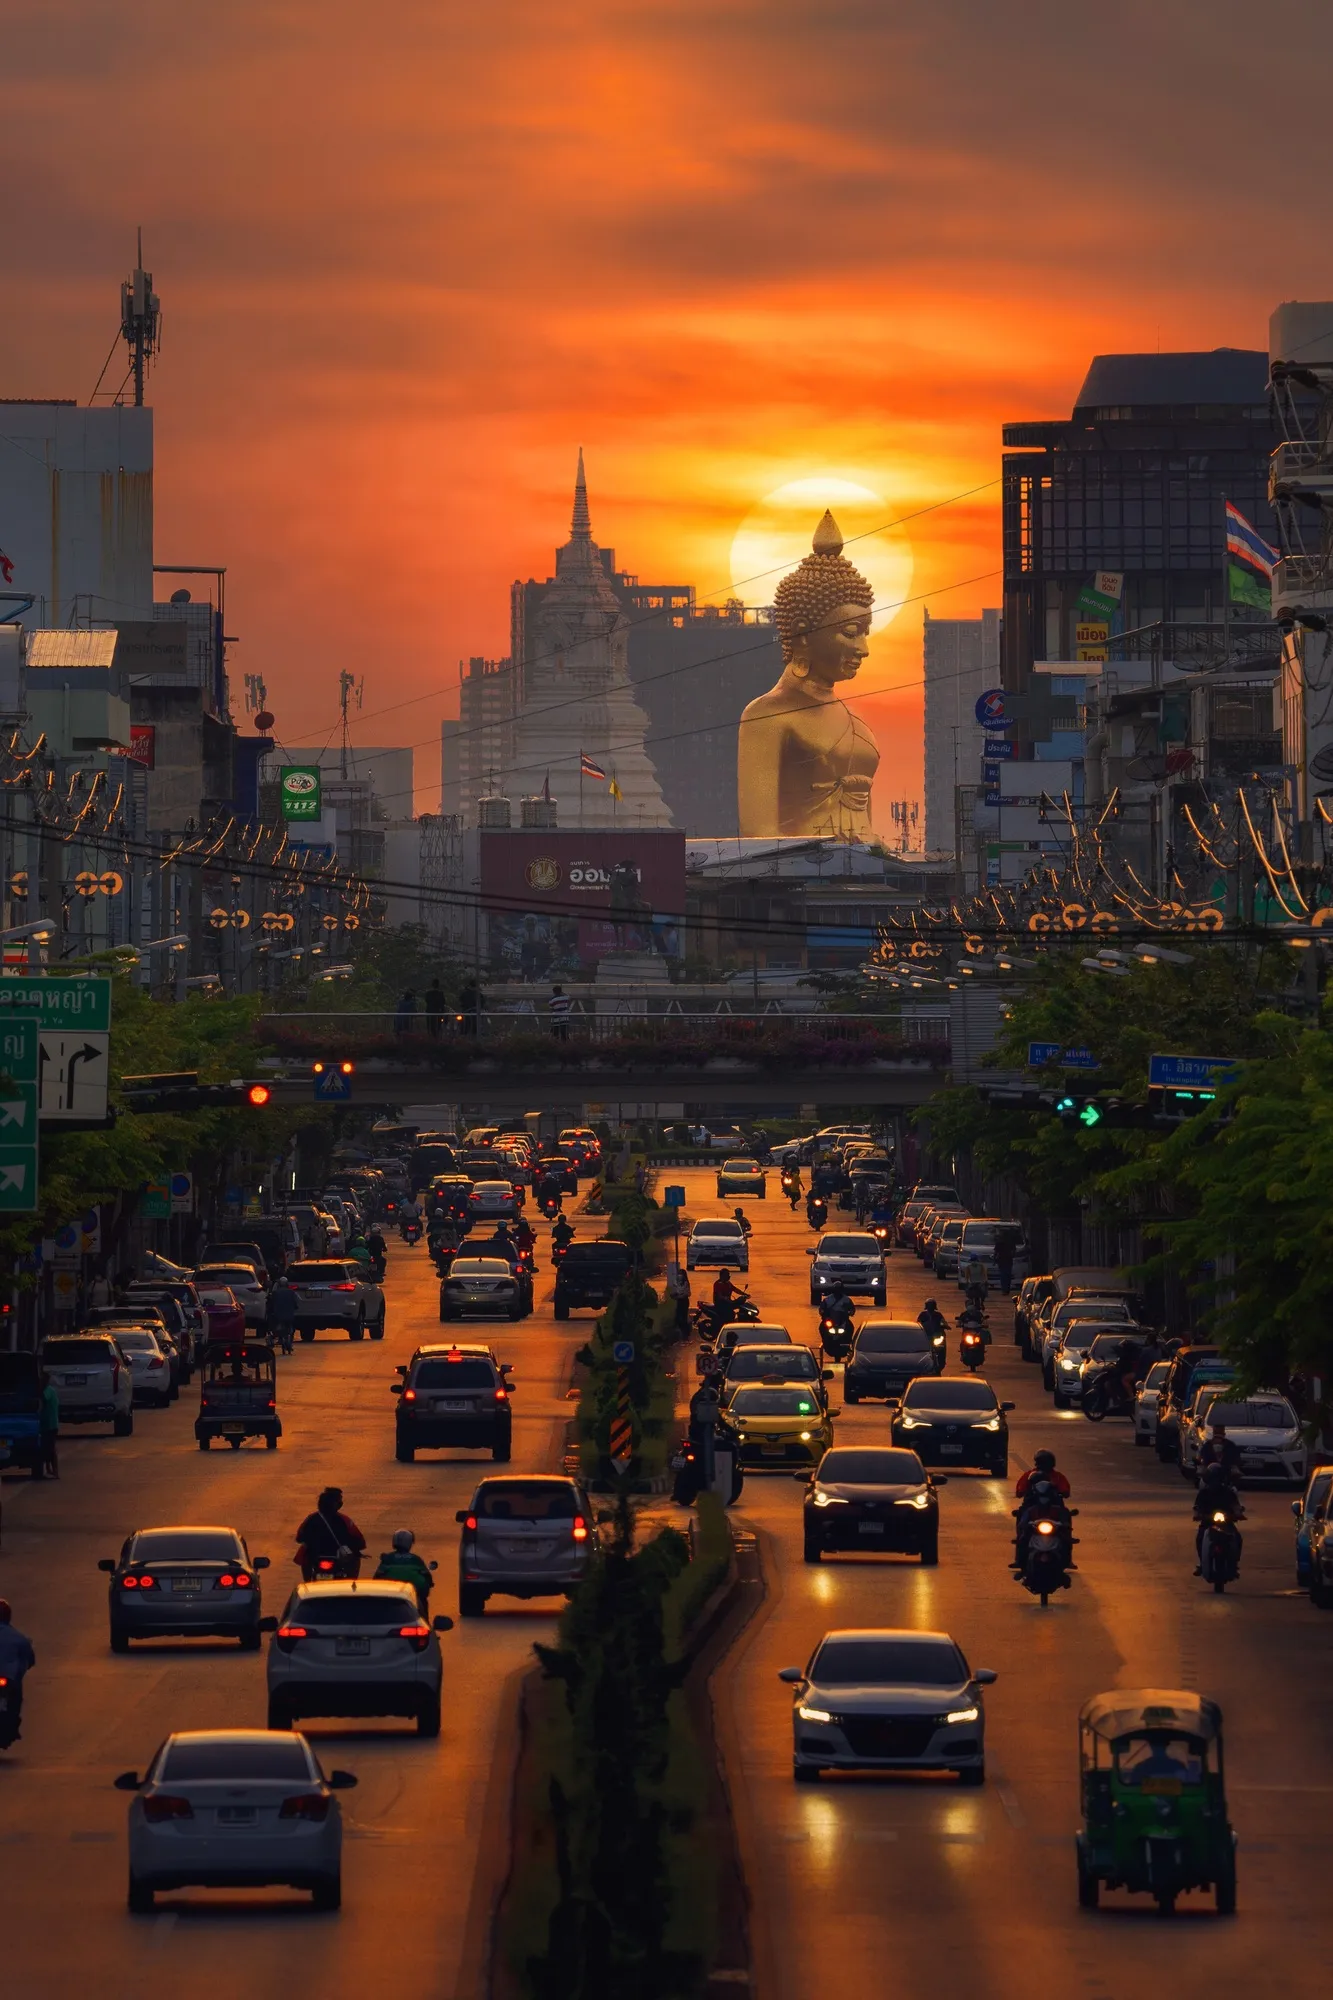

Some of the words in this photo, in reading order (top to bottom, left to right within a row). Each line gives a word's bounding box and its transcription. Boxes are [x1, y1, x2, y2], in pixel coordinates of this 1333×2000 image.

[1077, 627, 1107, 641] เมือง
[987, 743, 1011, 753] ประกัน
[285, 801, 317, 809] 1112
